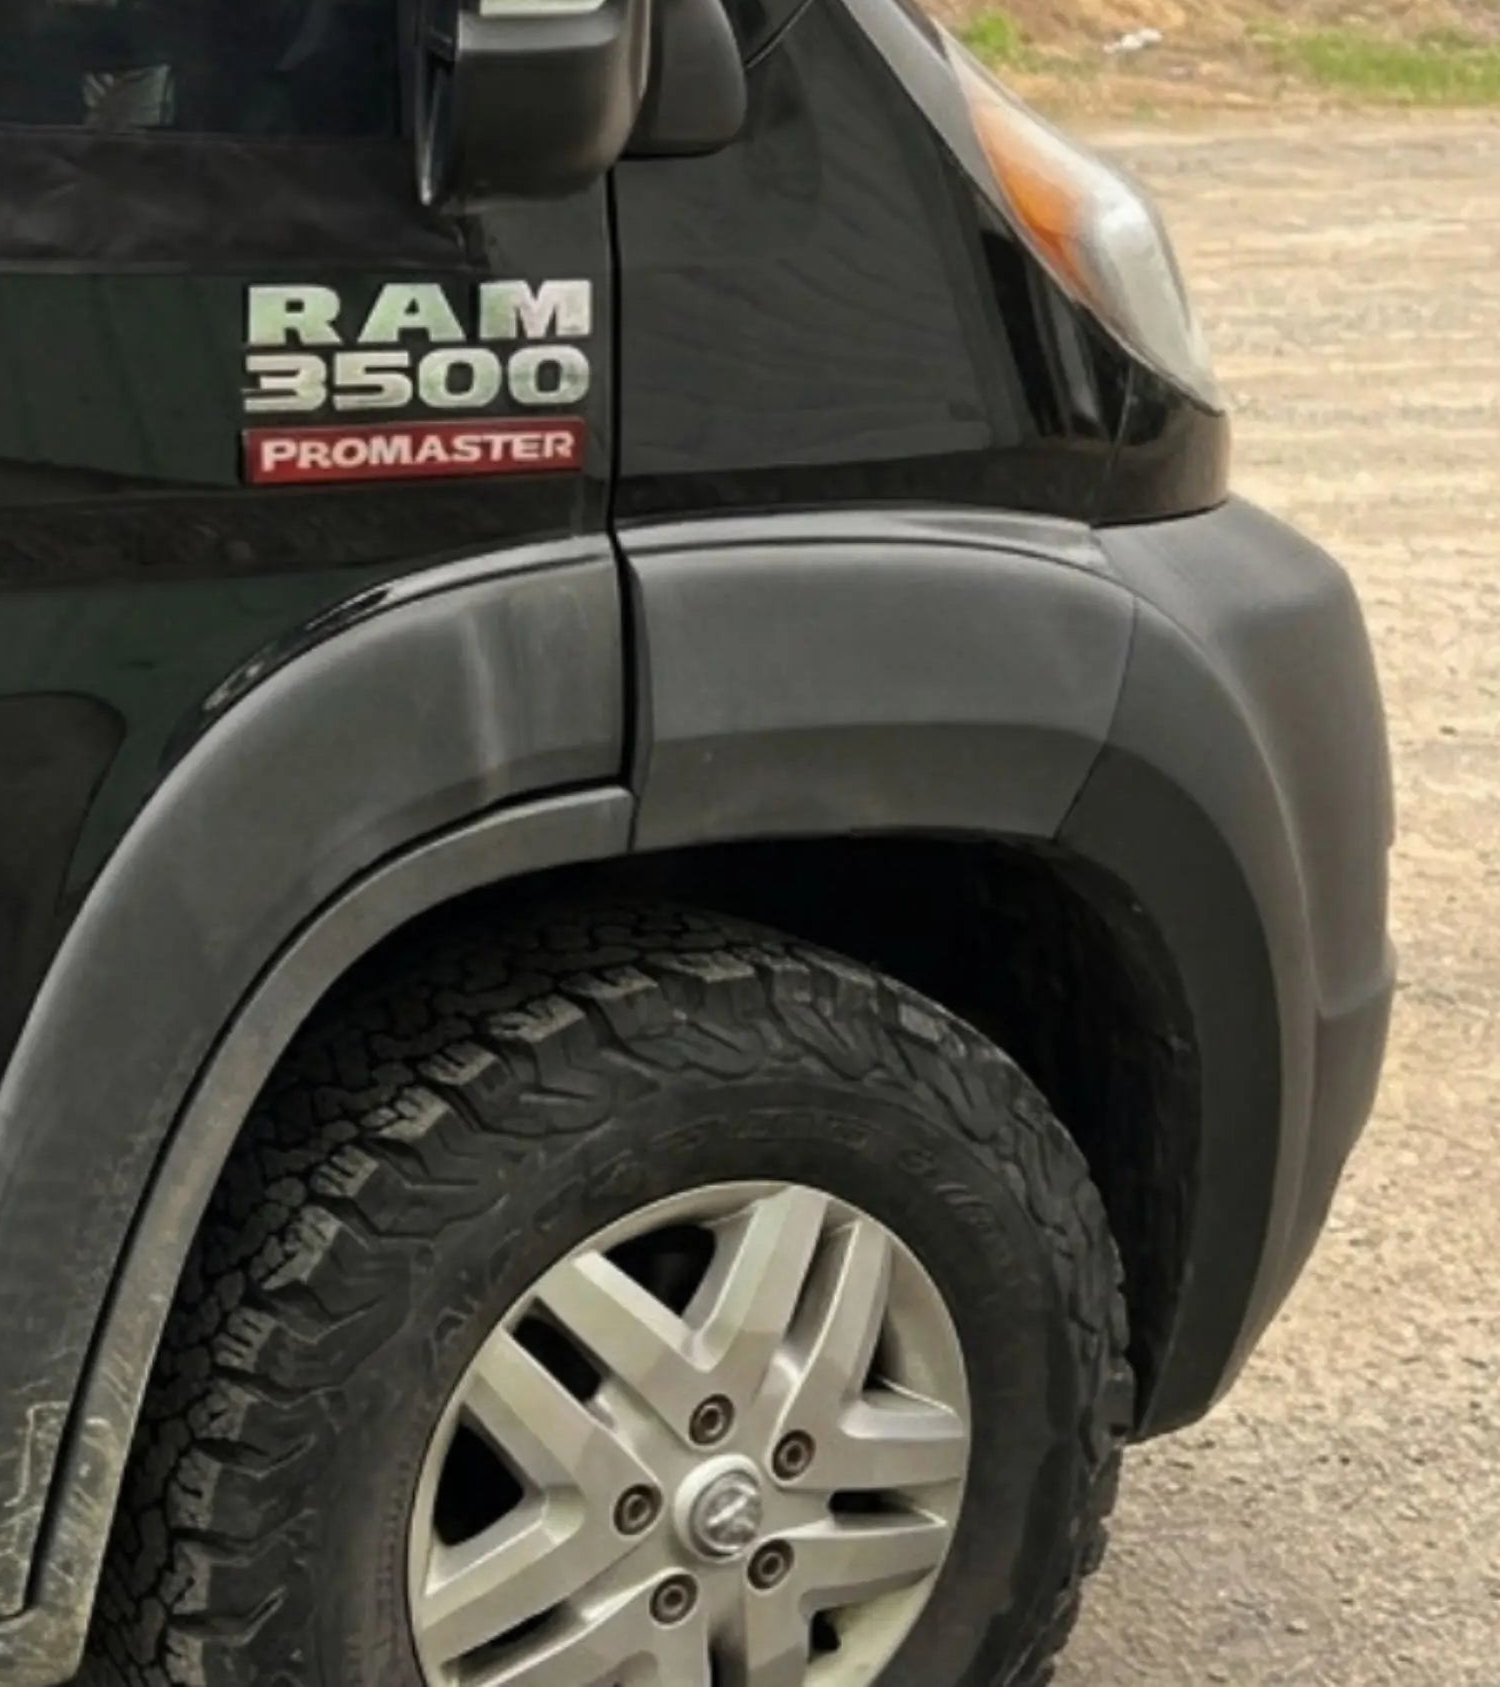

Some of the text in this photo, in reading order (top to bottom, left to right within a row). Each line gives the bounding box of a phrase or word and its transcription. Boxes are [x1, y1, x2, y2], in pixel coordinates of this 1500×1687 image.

[248, 279, 592, 345] RAM
[243, 344, 590, 411] 3500
[261, 430, 575, 472] PROMASTER
